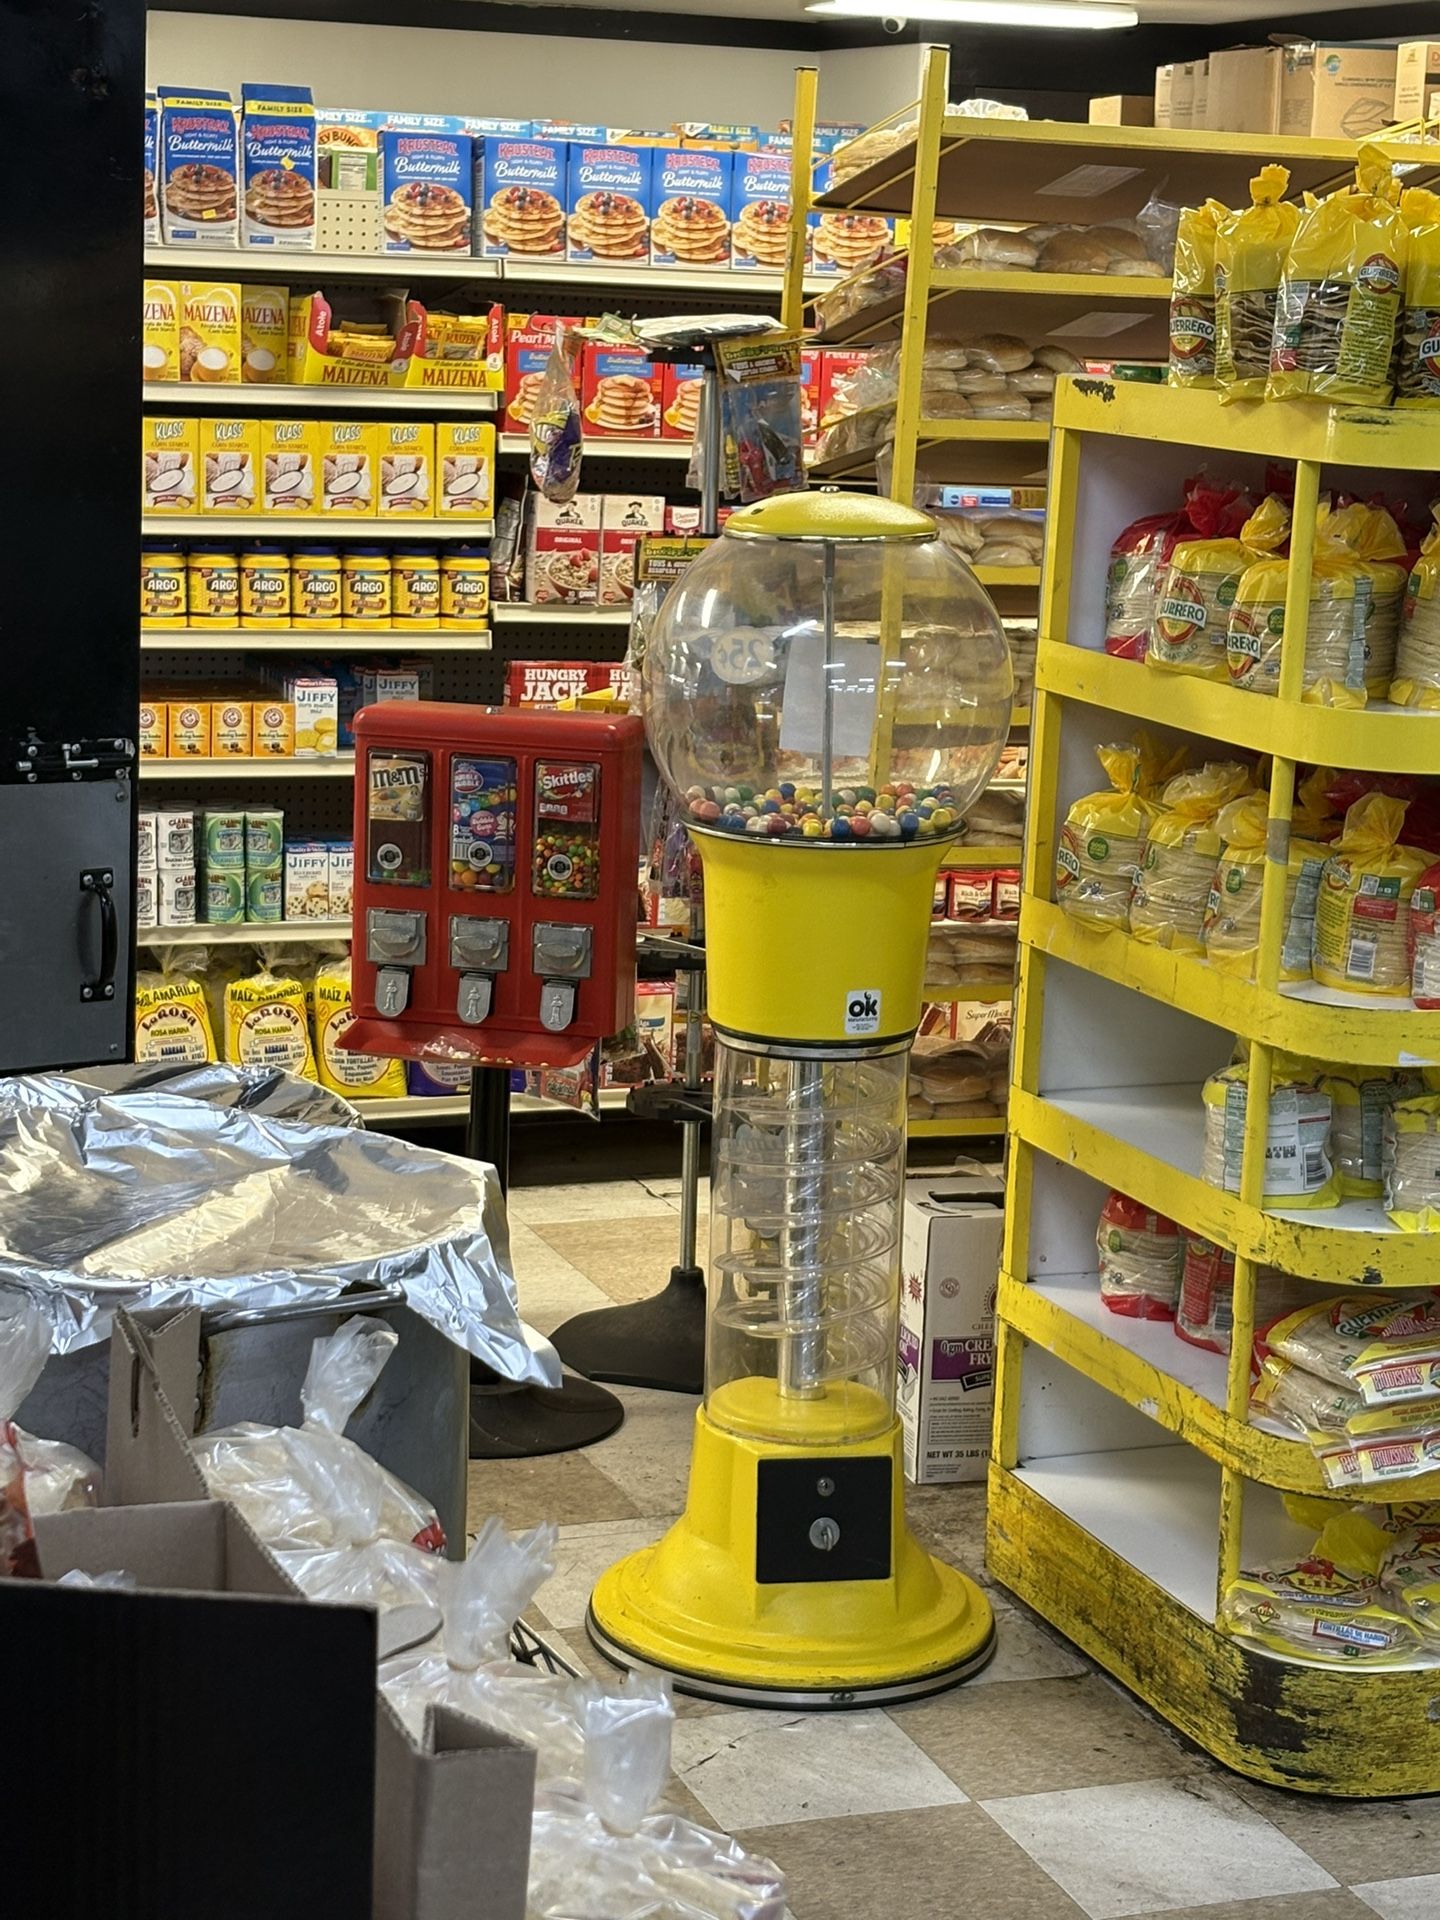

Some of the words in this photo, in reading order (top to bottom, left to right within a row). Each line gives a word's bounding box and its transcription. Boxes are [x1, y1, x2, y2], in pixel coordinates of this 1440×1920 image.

[345, 113, 368, 123] SIZE
[387, 115, 422, 126] FAMILY
[423, 117, 446, 127] SIZE
[465, 120, 499, 131] FAMILY
[500, 122, 521, 132] SIZE
[542, 126, 575, 135] FAMILY
[576, 127, 597, 136] SIZE
[815, 126, 840, 135] AMILY
[841, 127, 860, 136] SIZE
[168, 135, 234, 152] Buttermilk
[769, 135, 793, 145] FAMI
[248, 142, 312, 159] Buttermilk
[394, 157, 461, 175] Buttermilk
[494, 161, 558, 180] Buttermilk
[747, 157, 792, 174] KRUSTE
[579, 166, 642, 185] Buttermilk
[662, 171, 723, 190] Buttermilk
[744, 174, 789, 192] Butter
[144, 303, 175, 321] ZENA
[184, 304, 237, 323] MAIZENA
[243, 307, 285, 325] AIZENA
[316, 310, 327, 336] Atole
[511, 329, 545, 343] Pearl
[322, 365, 389, 386] MAIZENA
[422, 368, 487, 387] MAIZENA
[155, 422, 184, 440] KLASS
[215, 422, 245, 440] KLASS
[275, 423, 304, 442] KLASS
[333, 425, 362, 443] KLASS
[390, 426, 420, 444] KLASS
[453, 427, 481, 445] KLASS
[555, 517, 584, 526] QUAKER
[621, 518, 649, 527] QUAKER
[554, 536, 582, 544] ORIGINAL
[147, 579, 178, 591] ARGO
[211, 579, 237, 591] ARGO
[253, 580, 283, 591] ARGO
[307, 581, 336, 593] ARGO
[353, 581, 383, 593] ARGO
[412, 582, 438, 593] ARGO
[455, 582, 484, 594] ARGO
[524, 668, 588, 681] HUNGRY
[379, 678, 418, 690] JIFFY
[520, 681, 589, 701] JACK
[297, 690, 336, 703] JIFFY
[543, 771, 593, 790] Skittles
[289, 857, 326, 868] JIFFY
[331, 856, 353, 868] JIF
[153, 984, 200, 1003] AMARILL
[320, 986, 341, 1001] MAÍZ
[151, 1028, 167, 1037] ROSA
[255, 1027, 271, 1035] ROSA
[965, 1340, 992, 1352] CRE
[926, 1451, 941, 1459] NET
[942, 1450, 953, 1458] WT
[955, 1450, 965, 1458] 35
[966, 1449, 980, 1457] LBS
[1261, 1571, 1377, 1591] CALIDAD
[1319, 1621, 1352, 1635] TORTILLAS
